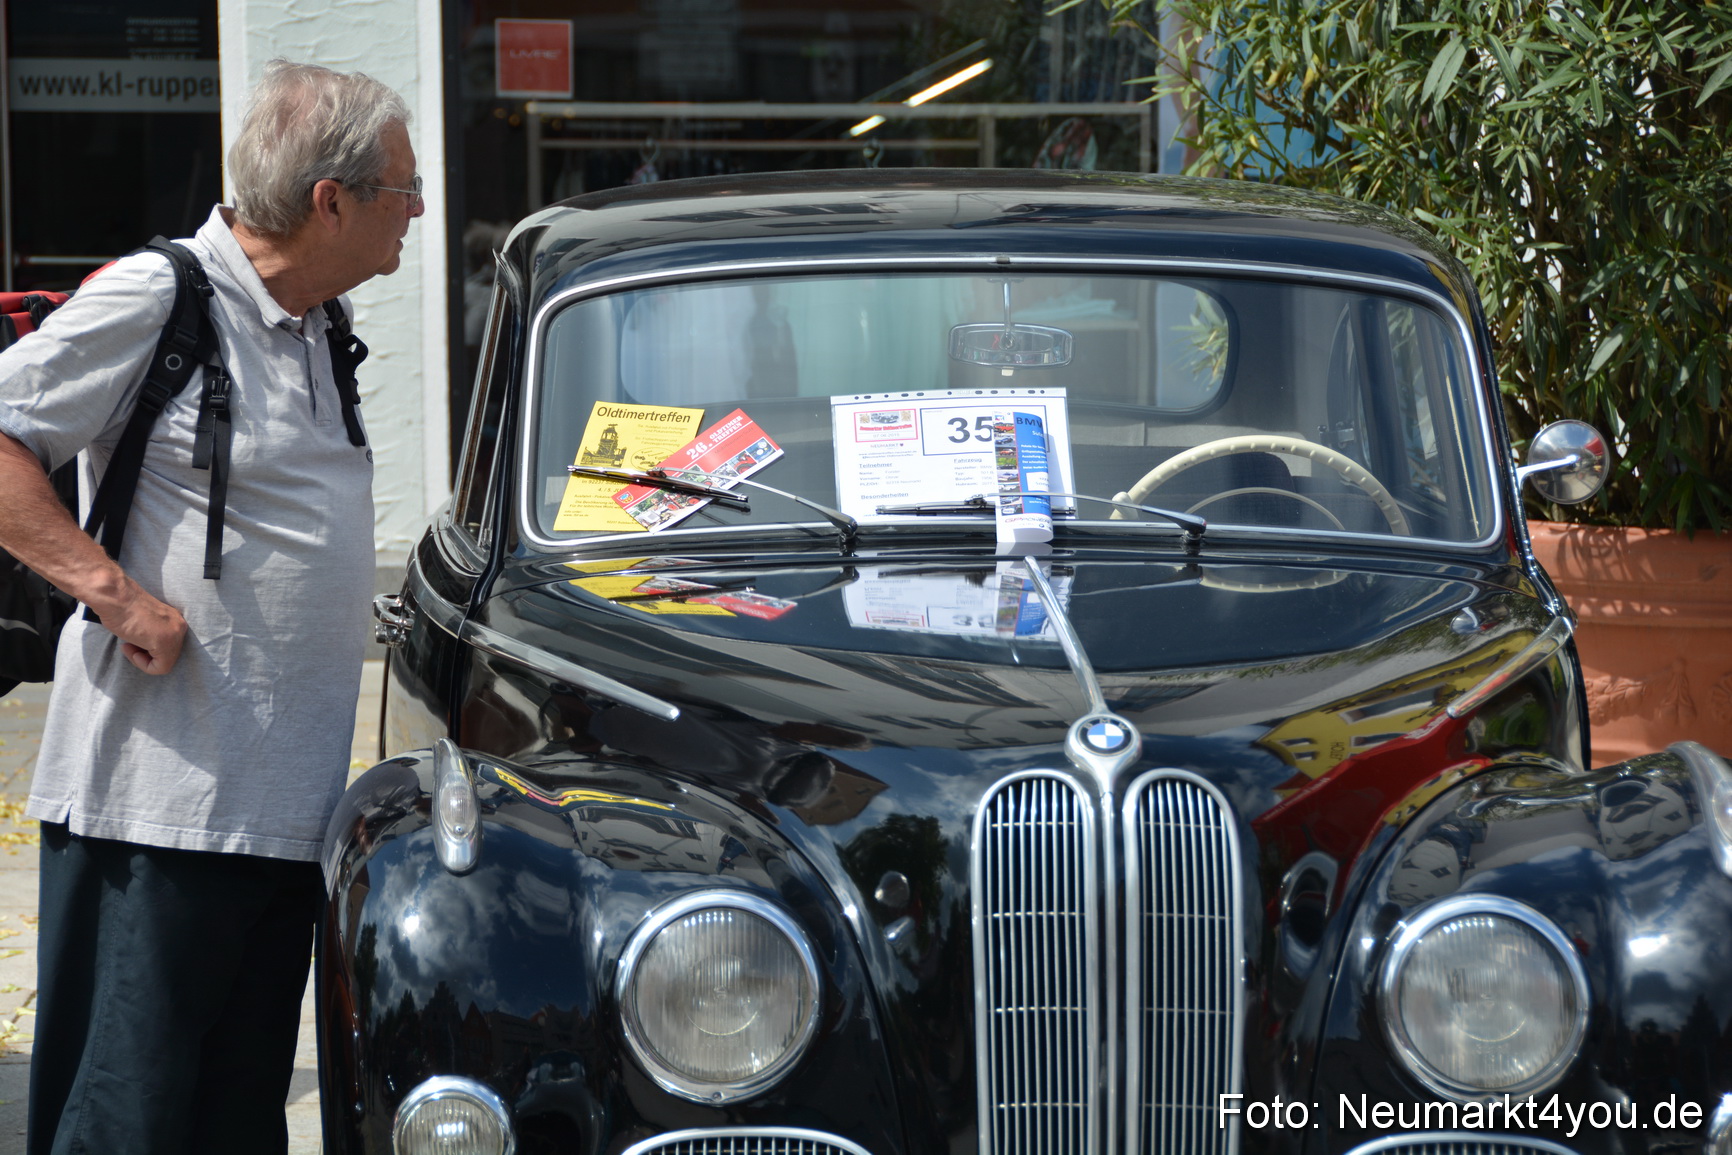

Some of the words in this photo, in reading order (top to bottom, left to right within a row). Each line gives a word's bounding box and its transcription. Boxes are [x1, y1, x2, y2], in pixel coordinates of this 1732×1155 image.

[597, 406, 691, 423] Oldtimertreffen
[686, 442, 713, 460] 26.
[712, 422, 742, 443] TREFFEN
[709, 416, 743, 440] OLDTIMER
[947, 416, 994, 444] 35
